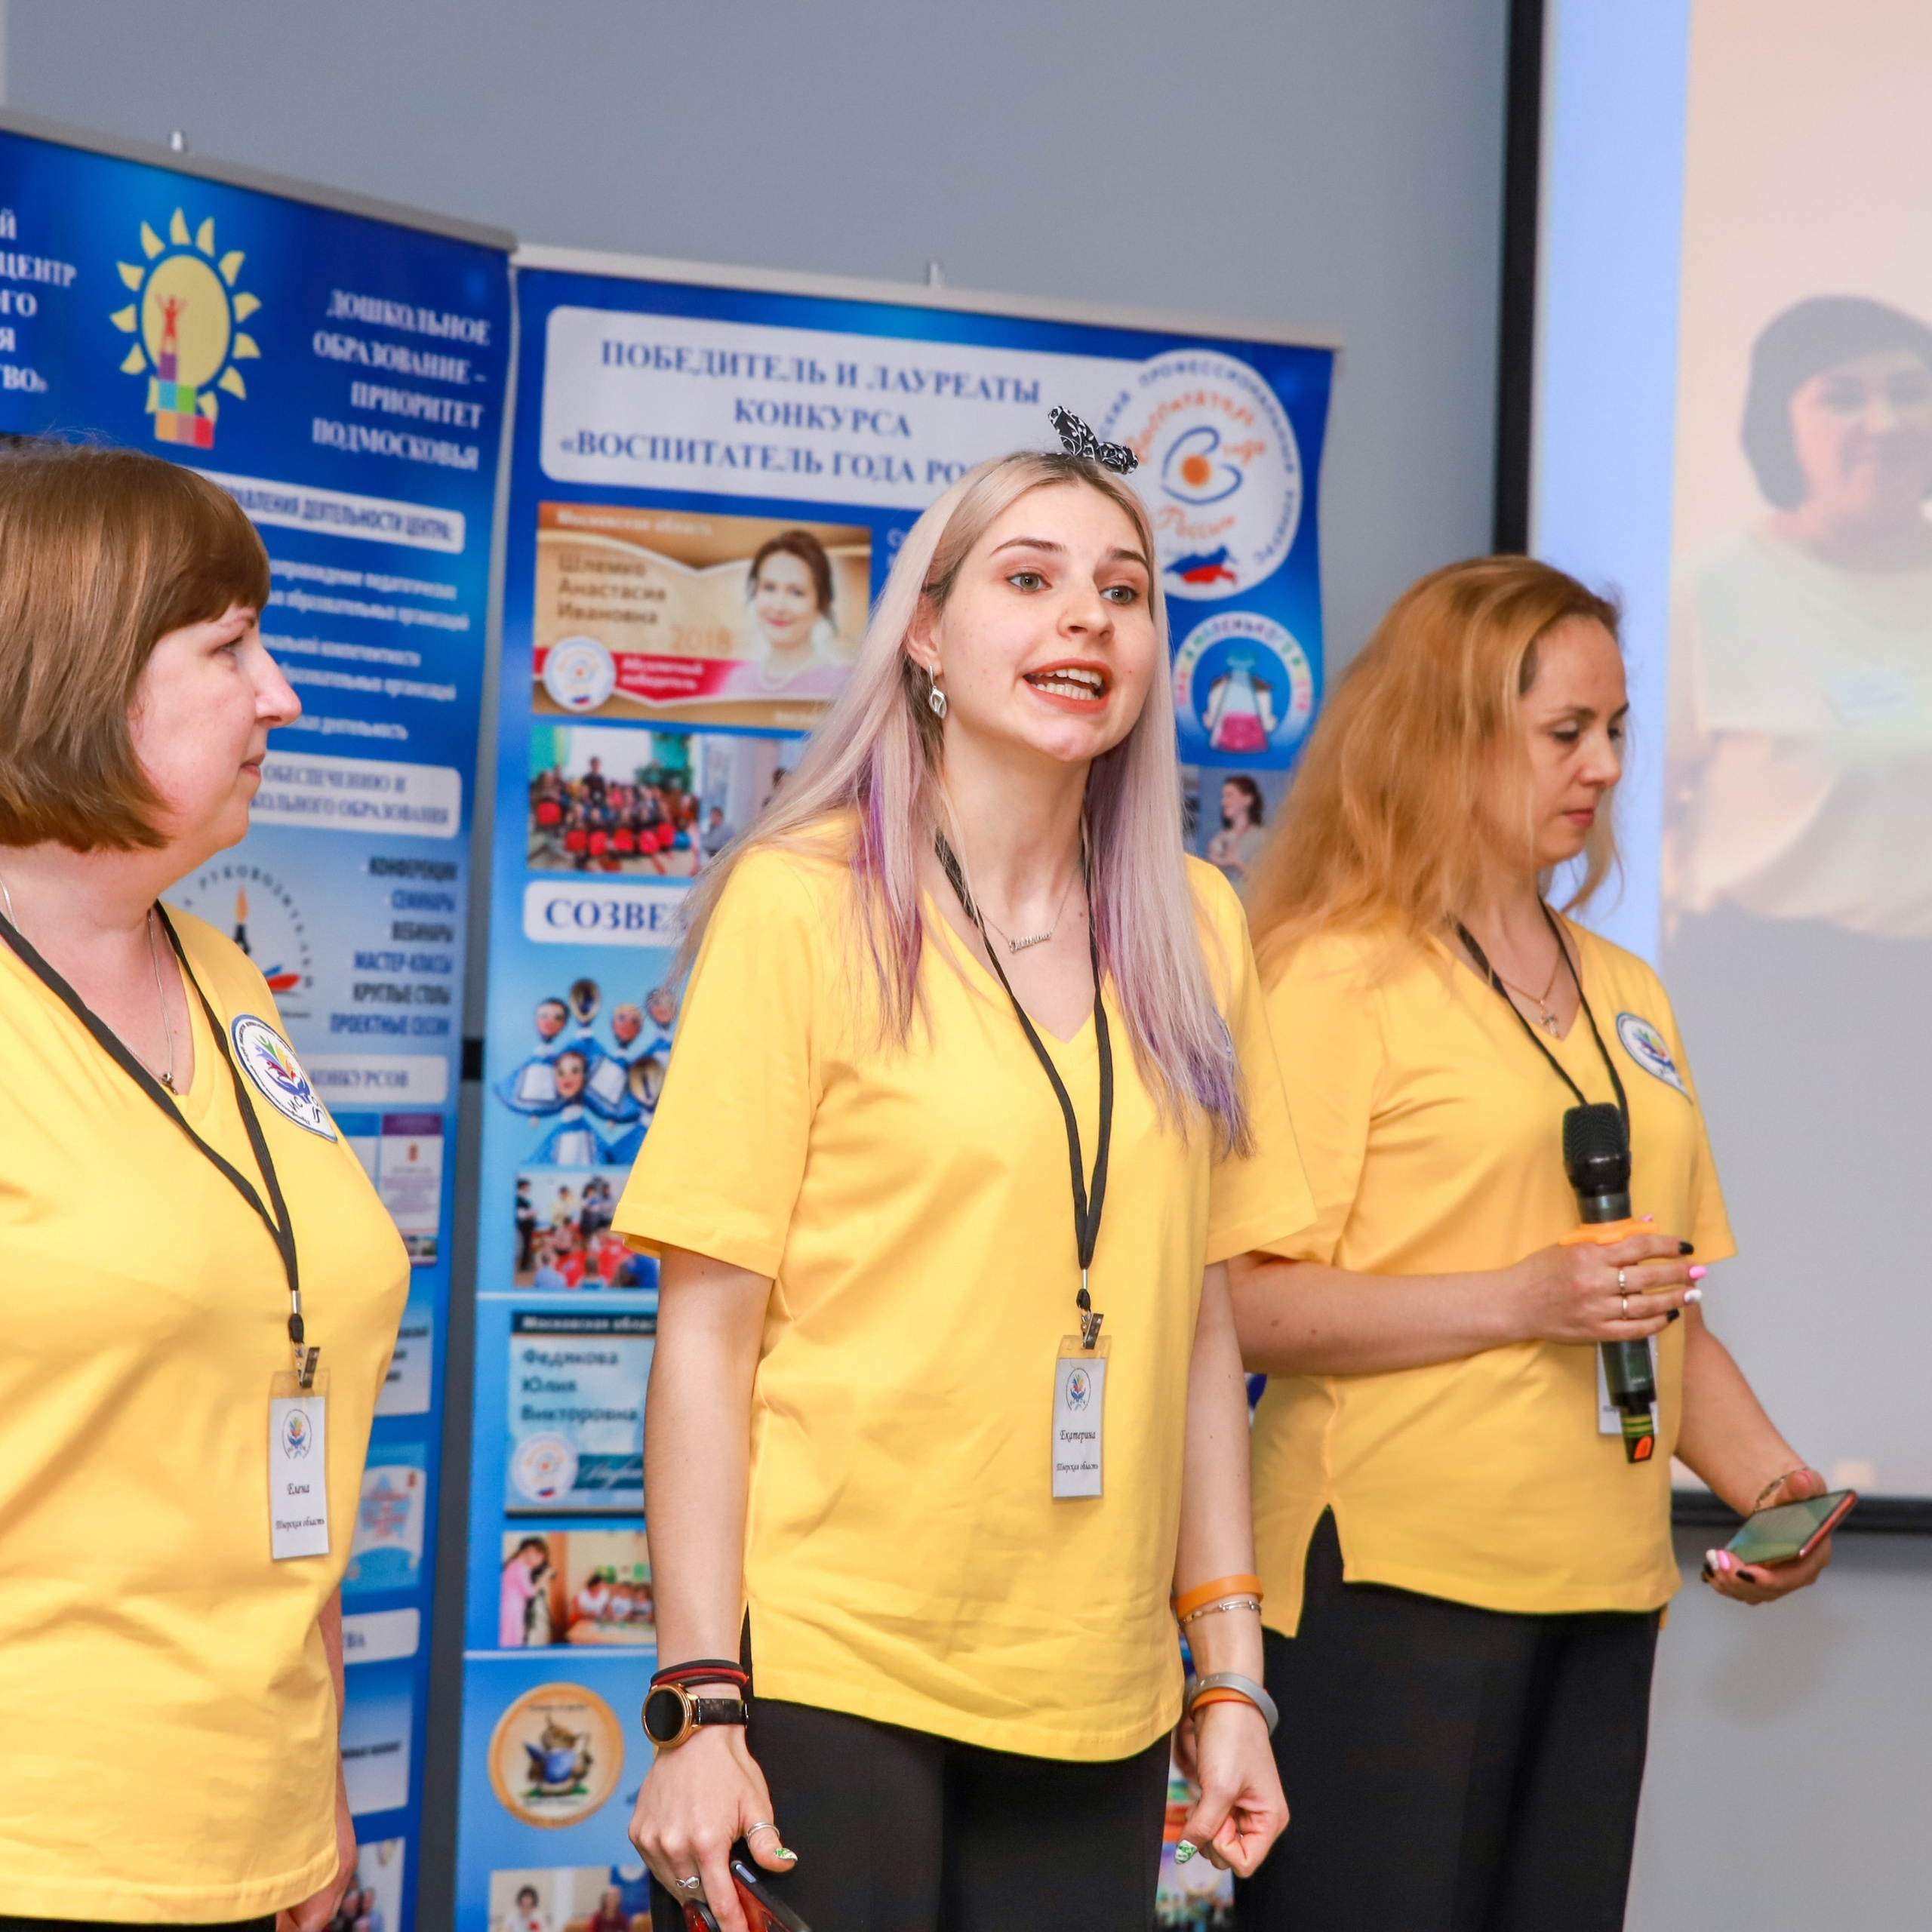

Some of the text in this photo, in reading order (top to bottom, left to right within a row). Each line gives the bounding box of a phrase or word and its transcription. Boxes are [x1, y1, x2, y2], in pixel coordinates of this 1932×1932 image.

[327, 289, 491, 346] ДОШКОЛЬНОЕ
[313, 330, 471, 385] ОБРАЗОВАНИЕ
[601, 340, 1041, 405] ПОБЕДИТЕЛЬ И ЛАУРЕАТЫ
[351, 380, 483, 429] ПРИОРИТЕТ
[734, 398, 912, 438] КОНКУРСА
[312, 417, 479, 471] ПОДМОСКОВЬЯ
[559, 429, 822, 476] «ВОСПИТАТЕЛЬ
[832, 453, 915, 486] ГОДА
[1060, 1429, 1096, 1444] Екатерина
[287, 1483, 309, 1495] Елена
